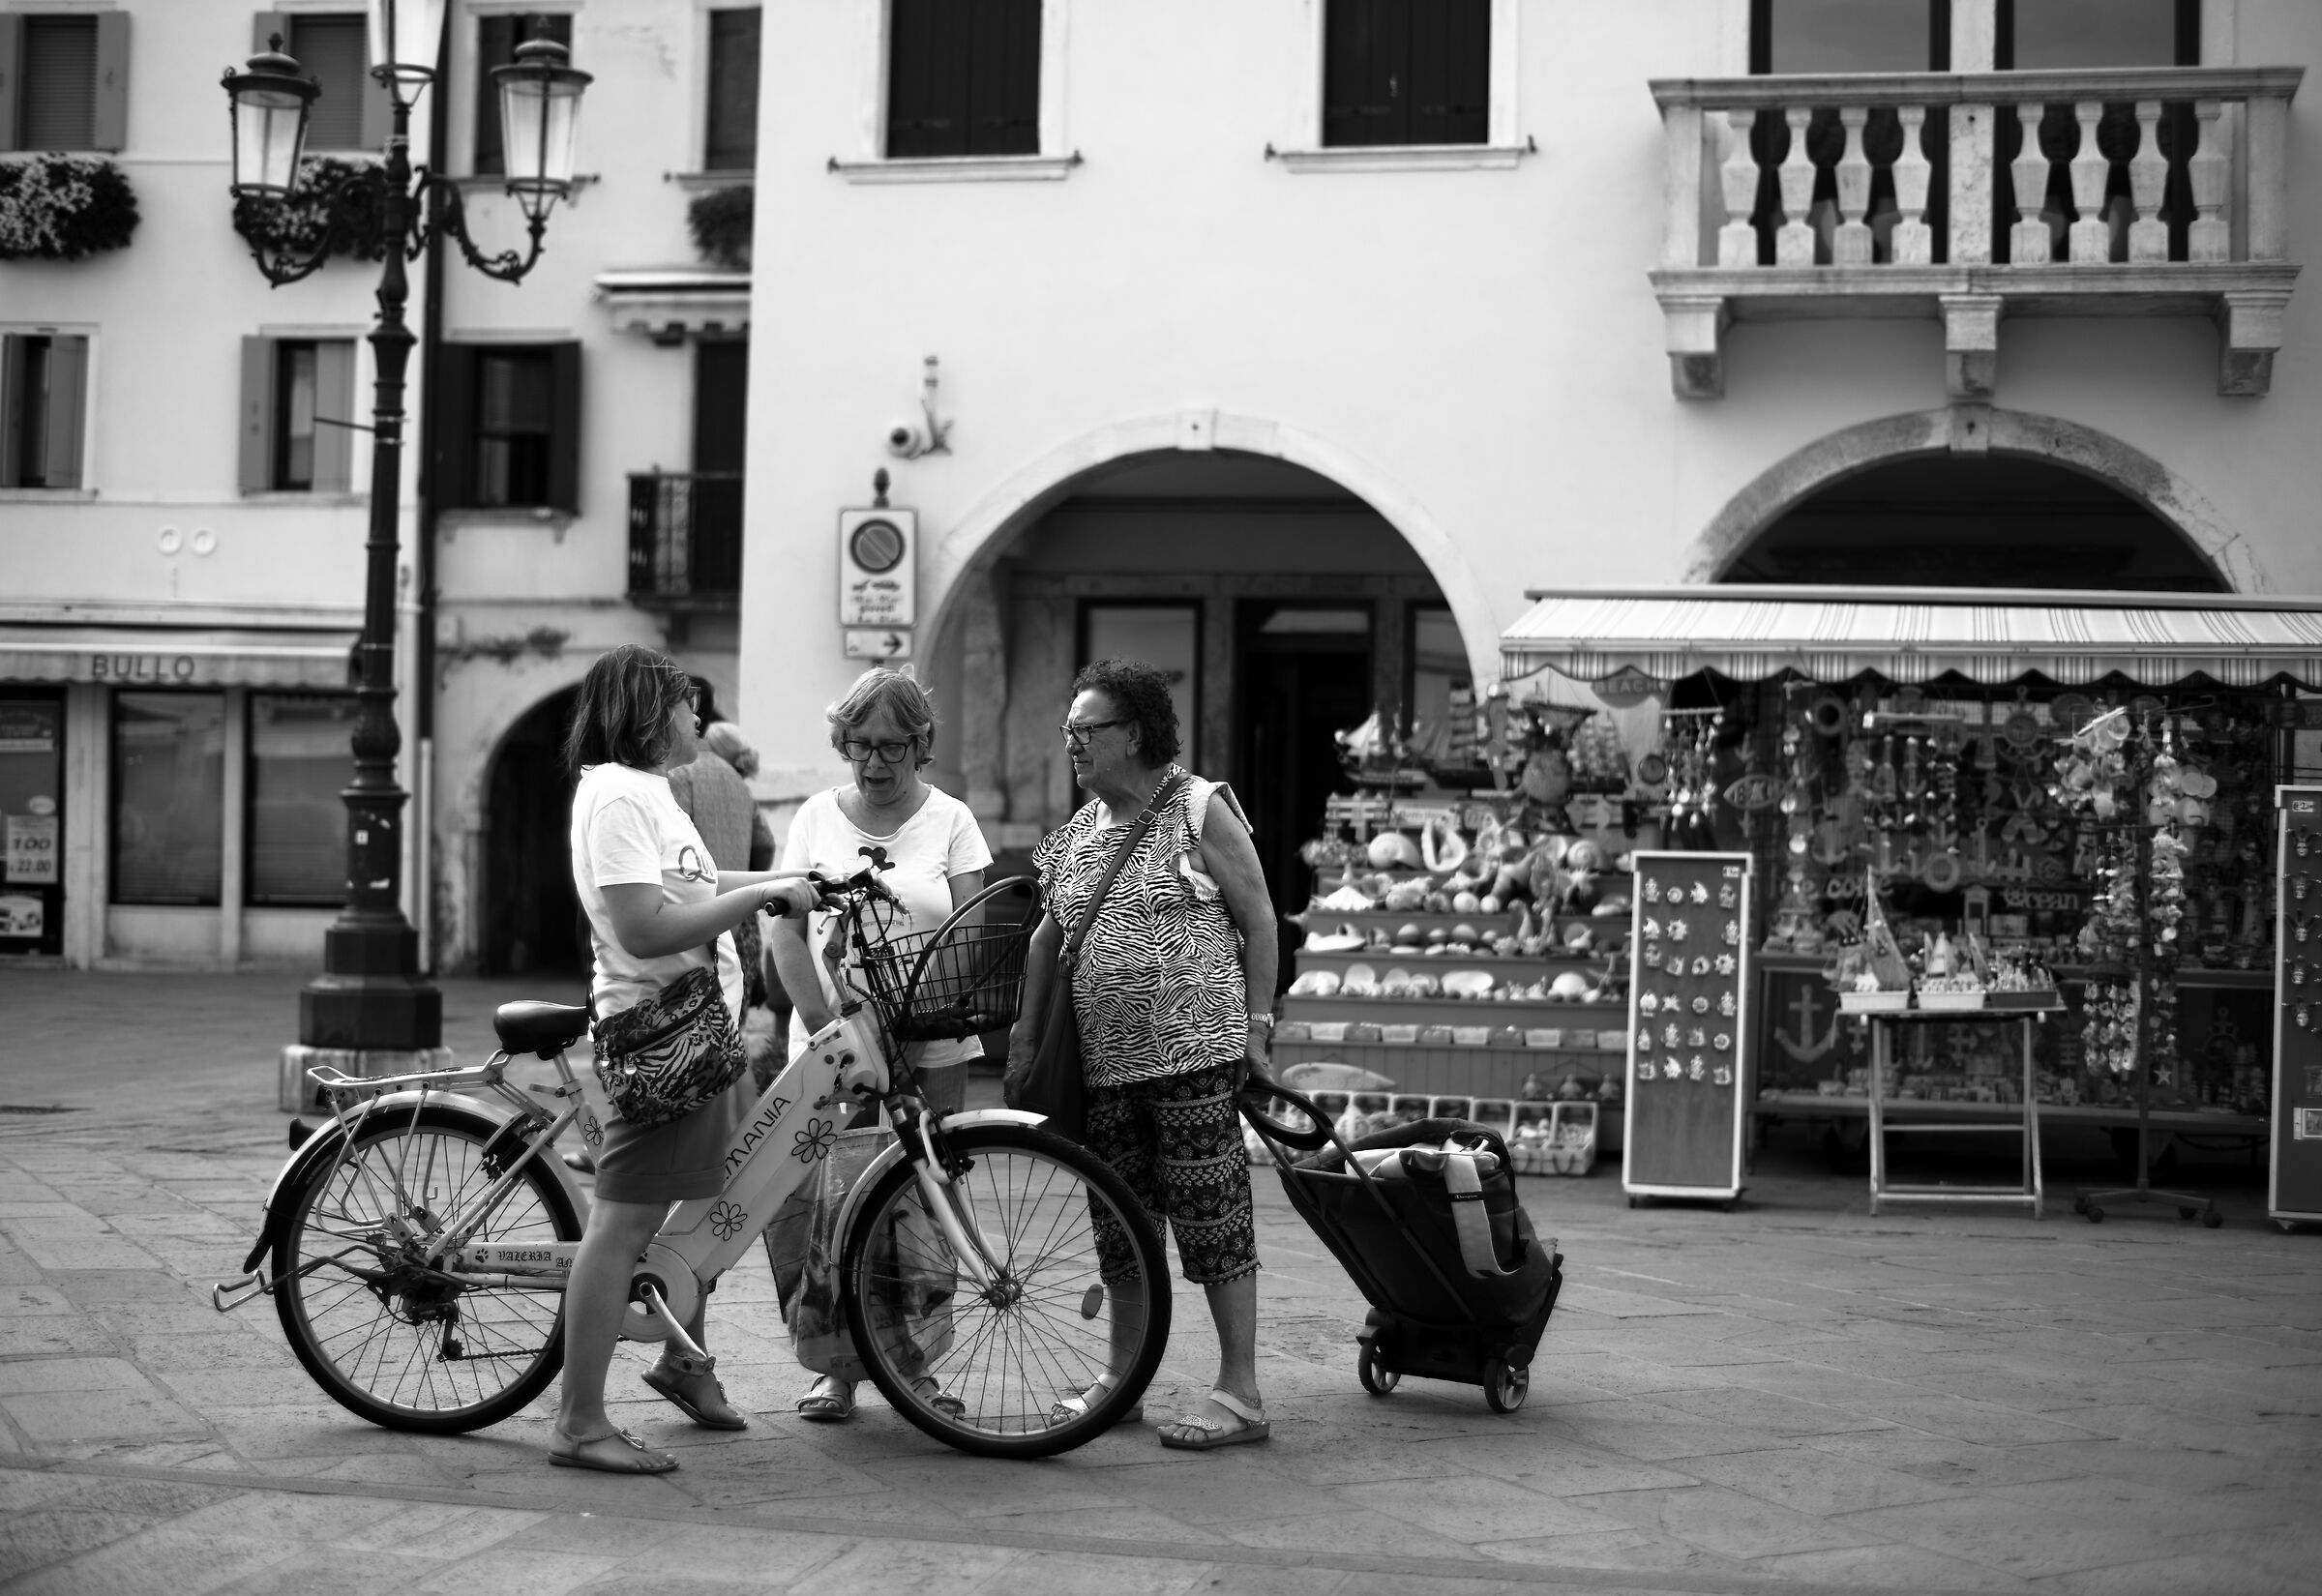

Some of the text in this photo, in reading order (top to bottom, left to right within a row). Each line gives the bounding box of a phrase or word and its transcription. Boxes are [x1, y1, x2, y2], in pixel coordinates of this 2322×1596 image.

[92, 654, 195, 679] BULLO
[724, 1096, 791, 1178] MANIA
[498, 1251, 551, 1262] VALERIA
